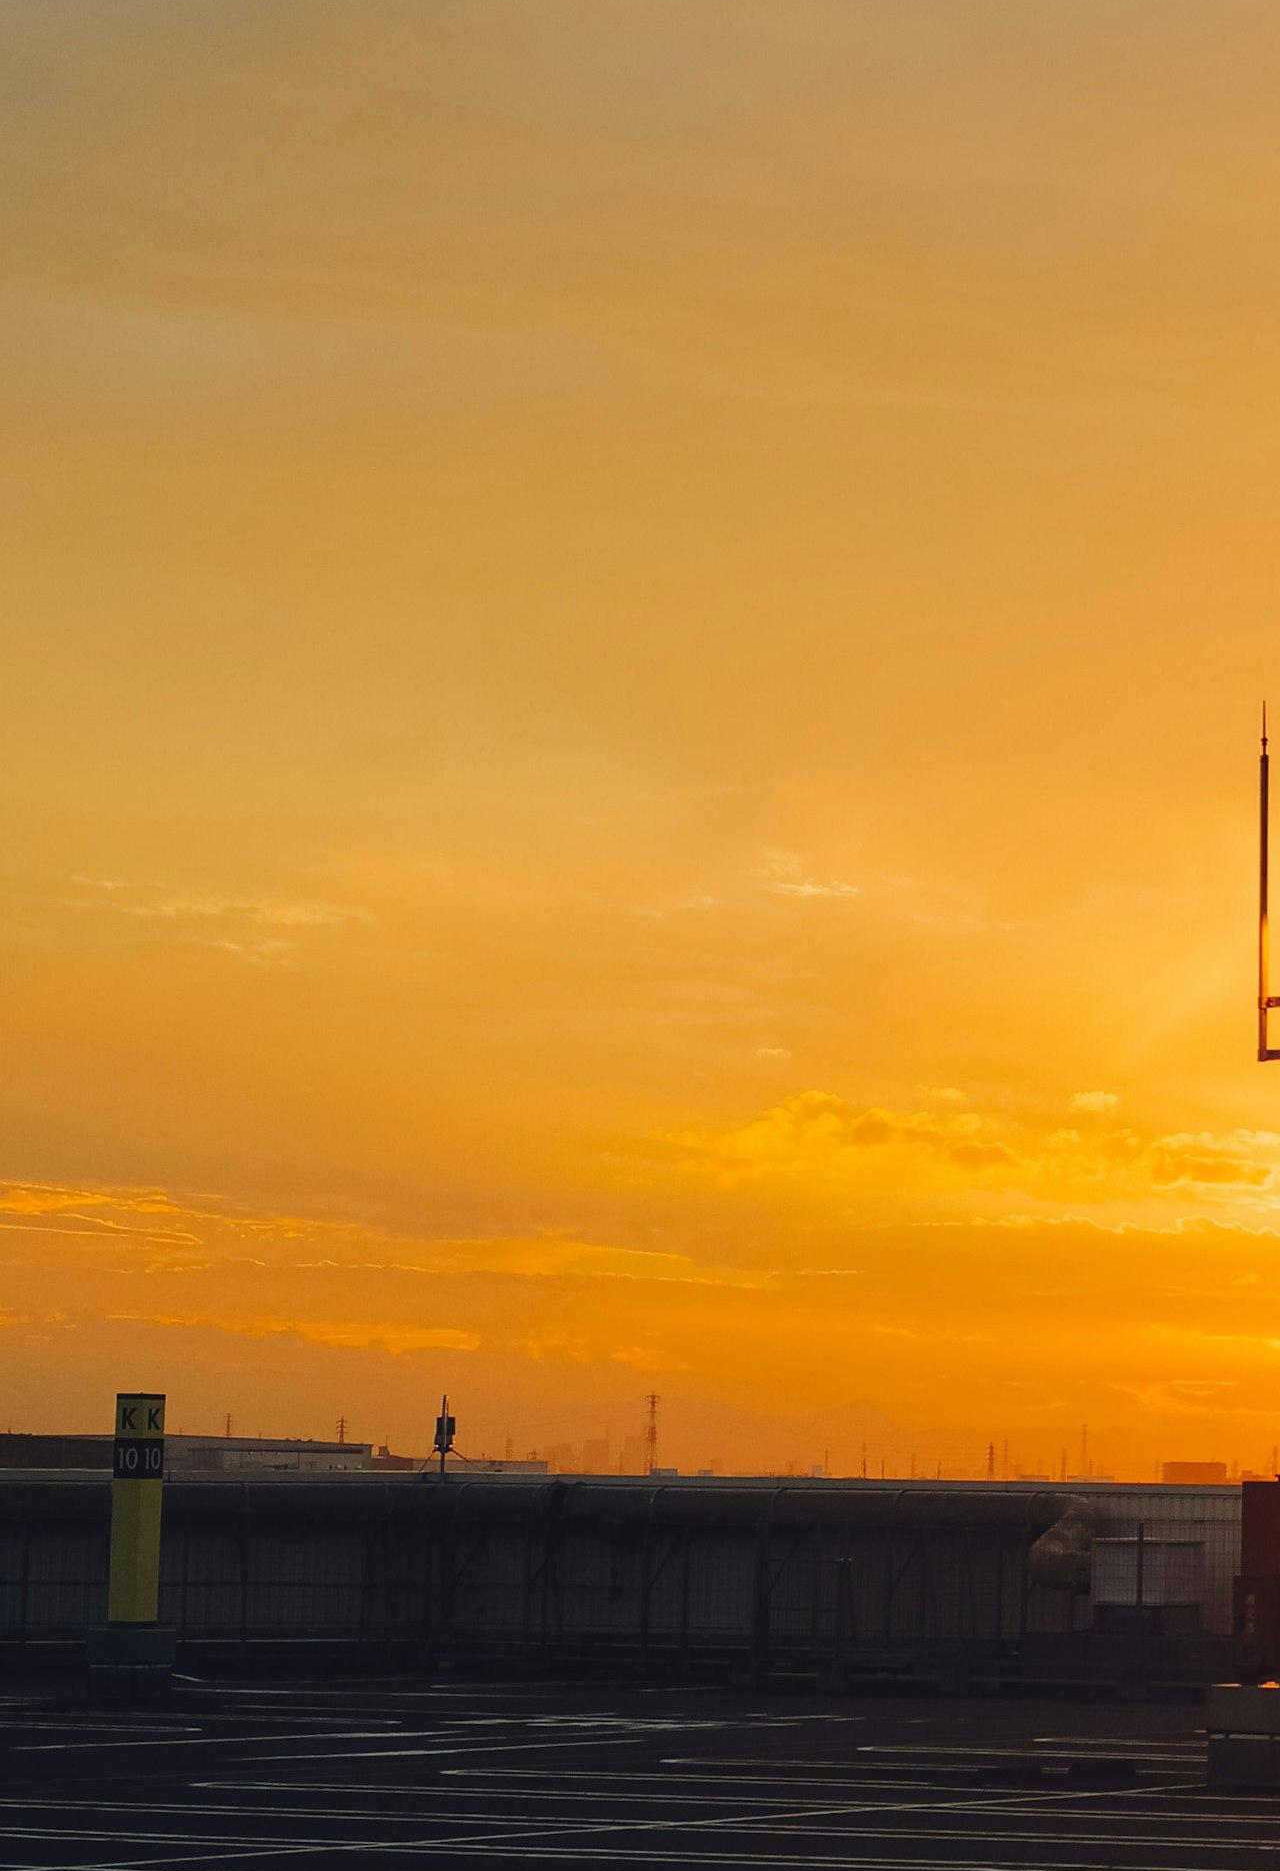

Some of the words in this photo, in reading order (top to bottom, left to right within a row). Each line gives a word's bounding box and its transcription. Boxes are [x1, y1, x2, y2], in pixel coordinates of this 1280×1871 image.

[121, 1407, 138, 1430] K
[147, 1408, 160, 1430] K
[118, 1447, 138, 1470] 10
[144, 1447, 161, 1470] 10
